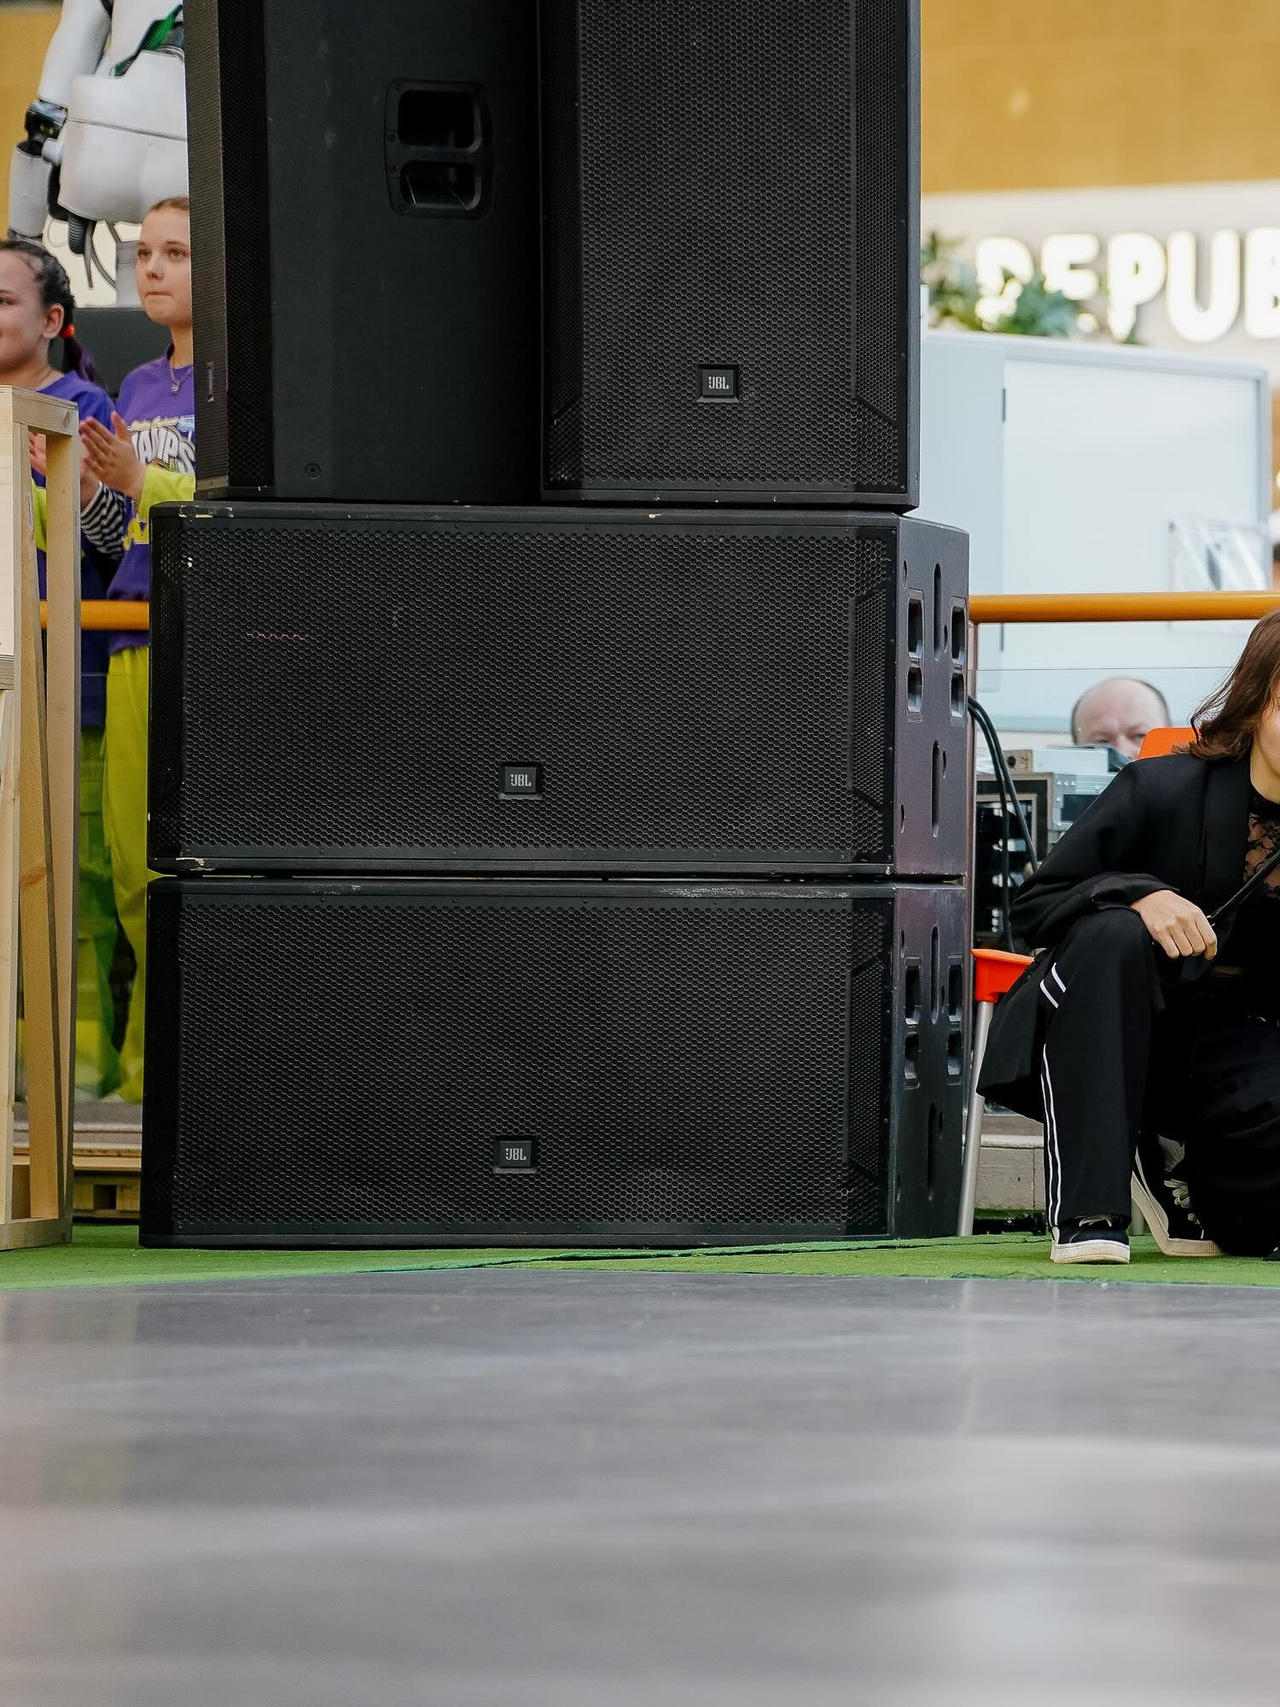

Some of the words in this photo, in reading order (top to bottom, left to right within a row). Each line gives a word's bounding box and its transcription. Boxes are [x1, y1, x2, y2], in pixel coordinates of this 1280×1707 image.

[708, 376, 730, 390] JBL
[510, 774, 532, 787] JBL
[505, 1147, 527, 1161] JBL
